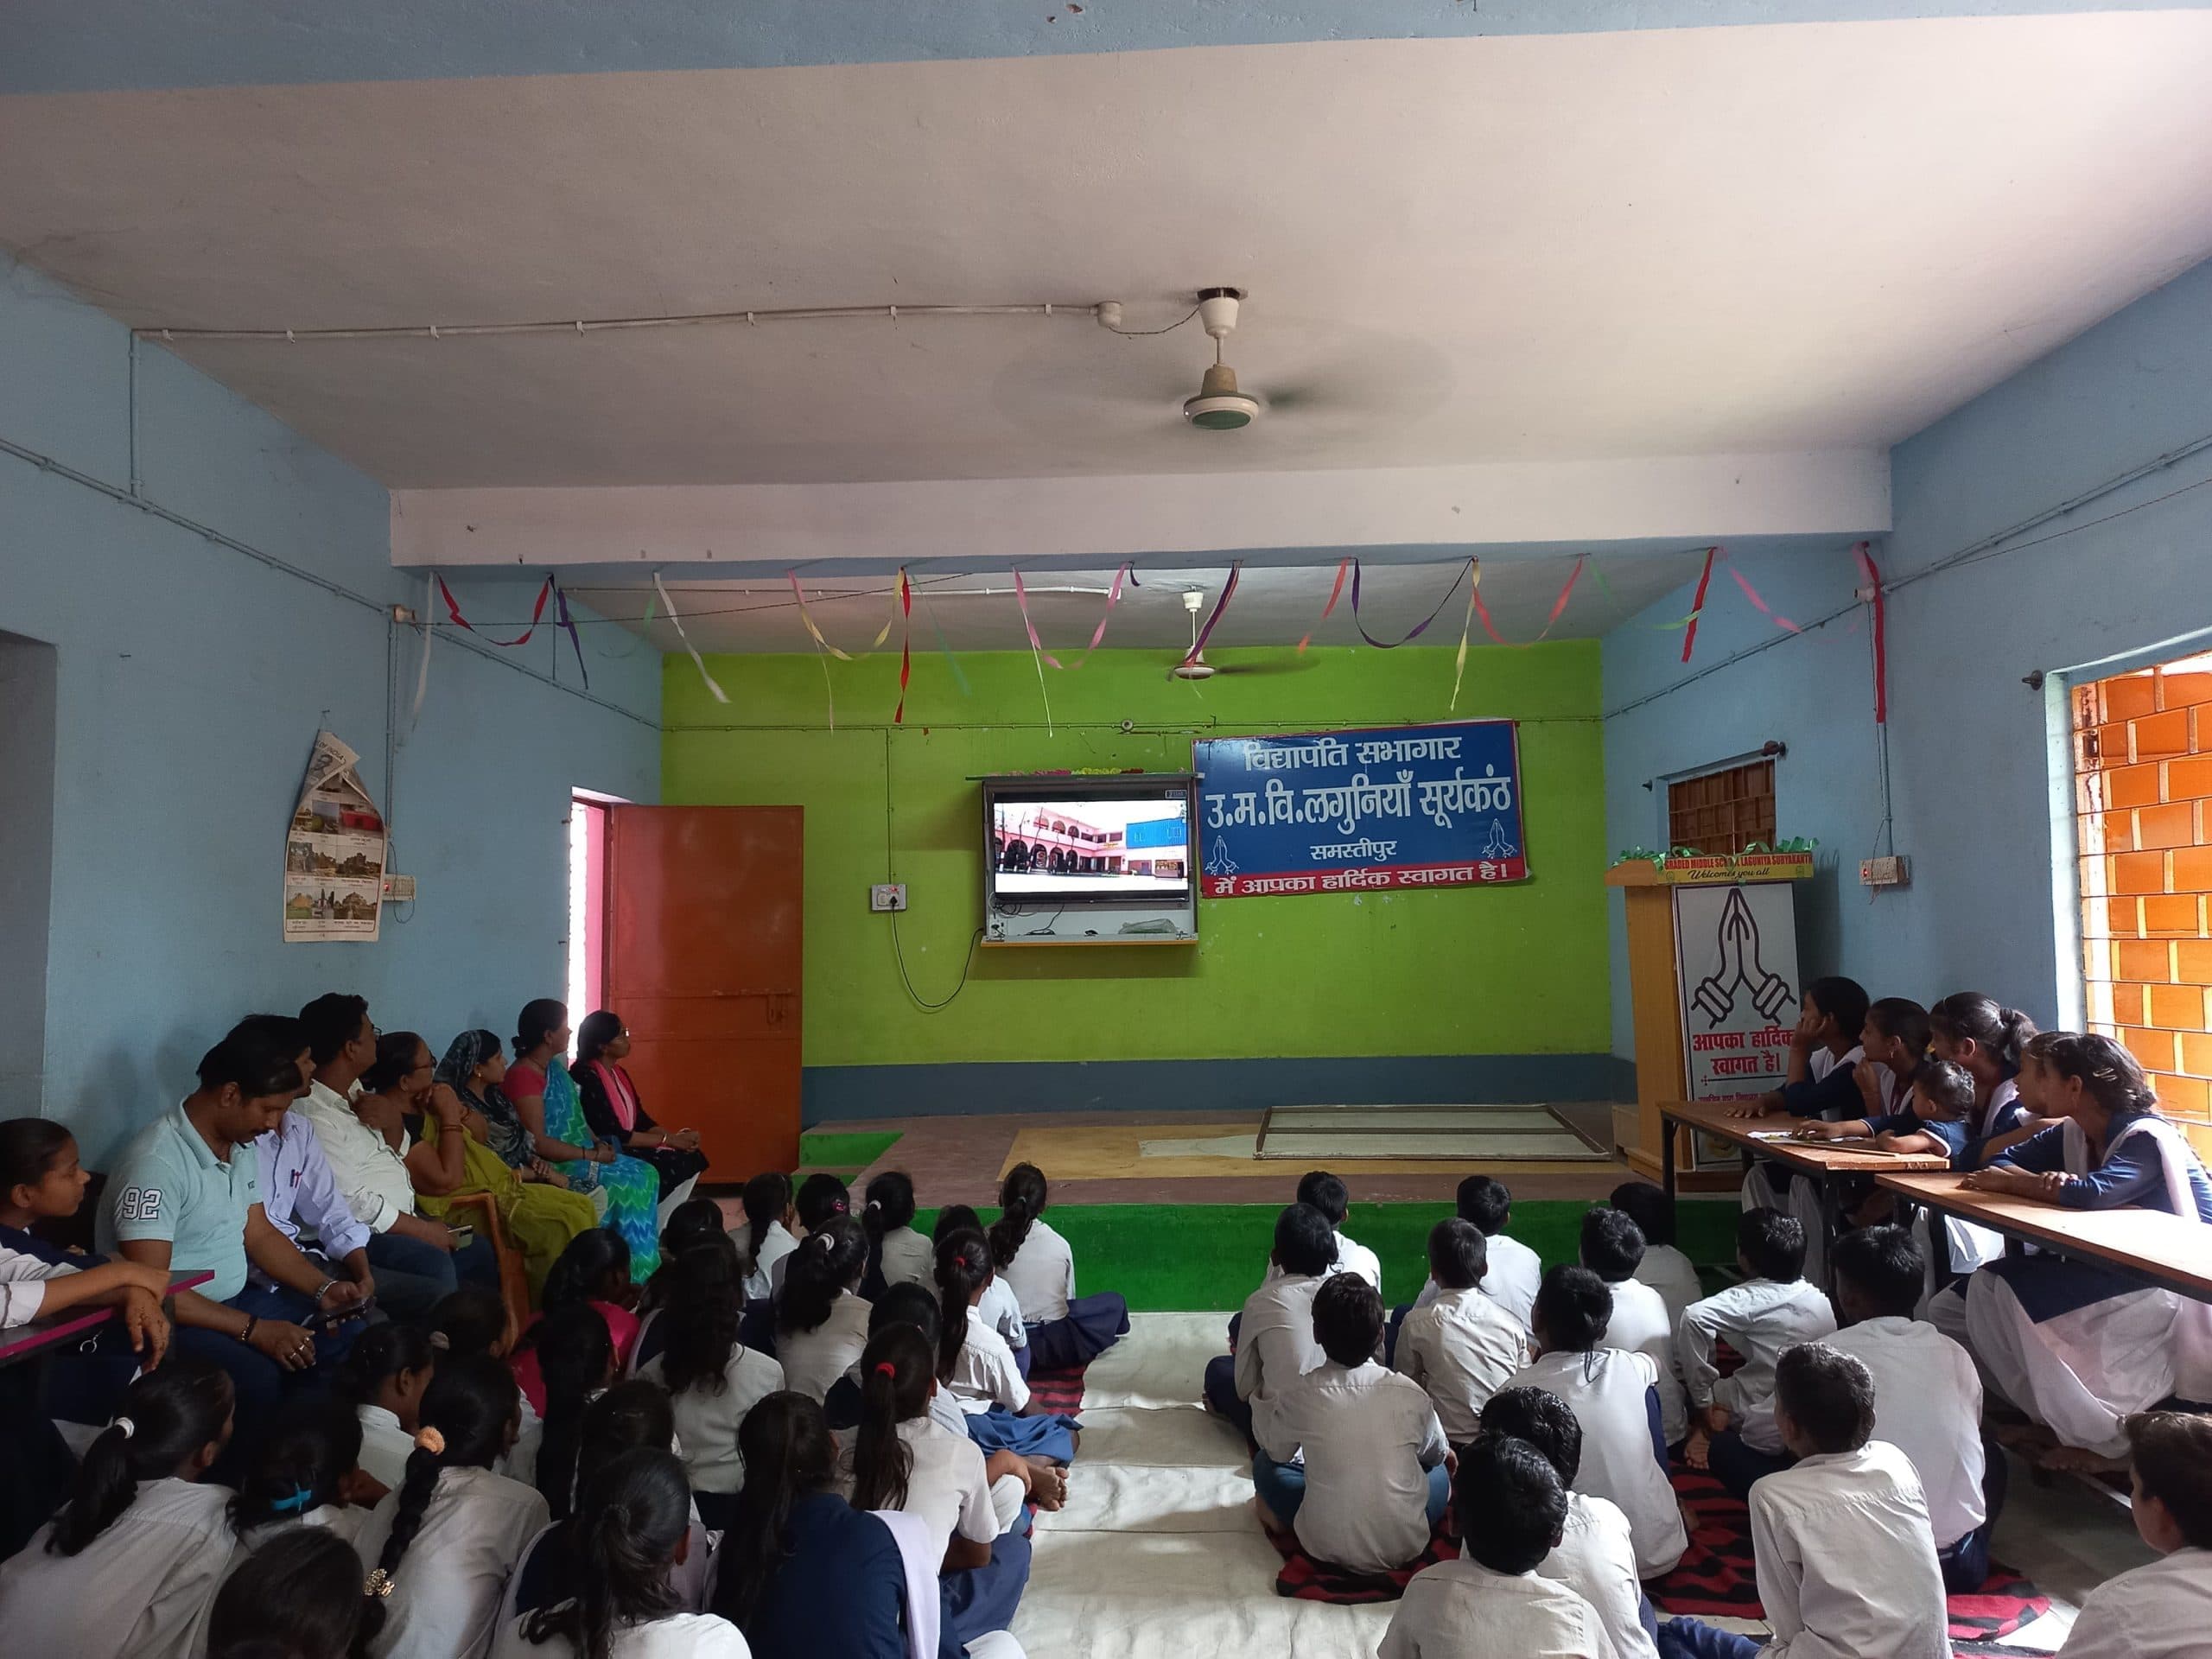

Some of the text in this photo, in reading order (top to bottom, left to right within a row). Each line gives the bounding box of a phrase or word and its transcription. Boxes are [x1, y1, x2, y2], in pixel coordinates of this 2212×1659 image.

[1244, 736, 1462, 771] विद्यापति सभागार
[1418, 764, 1511, 829] सूर्यकंठ
[1310, 838, 1397, 861] समस्तीपुर
[1690, 858, 1713, 868] MIDDLE
[1714, 856, 1740, 868] SCOL
[1734, 870, 1753, 880] you
[1755, 867, 1770, 875] all
[1214, 875, 1236, 895] में
[1242, 875, 1316, 893] आपका
[1322, 868, 1392, 890] हार्दिक
[1397, 865, 1473, 884] स्वागत
[1692, 1032, 1745, 1051] आपका
[1710, 1056, 1758, 1075] स्वागत
[123, 1186, 162, 1220] 92
